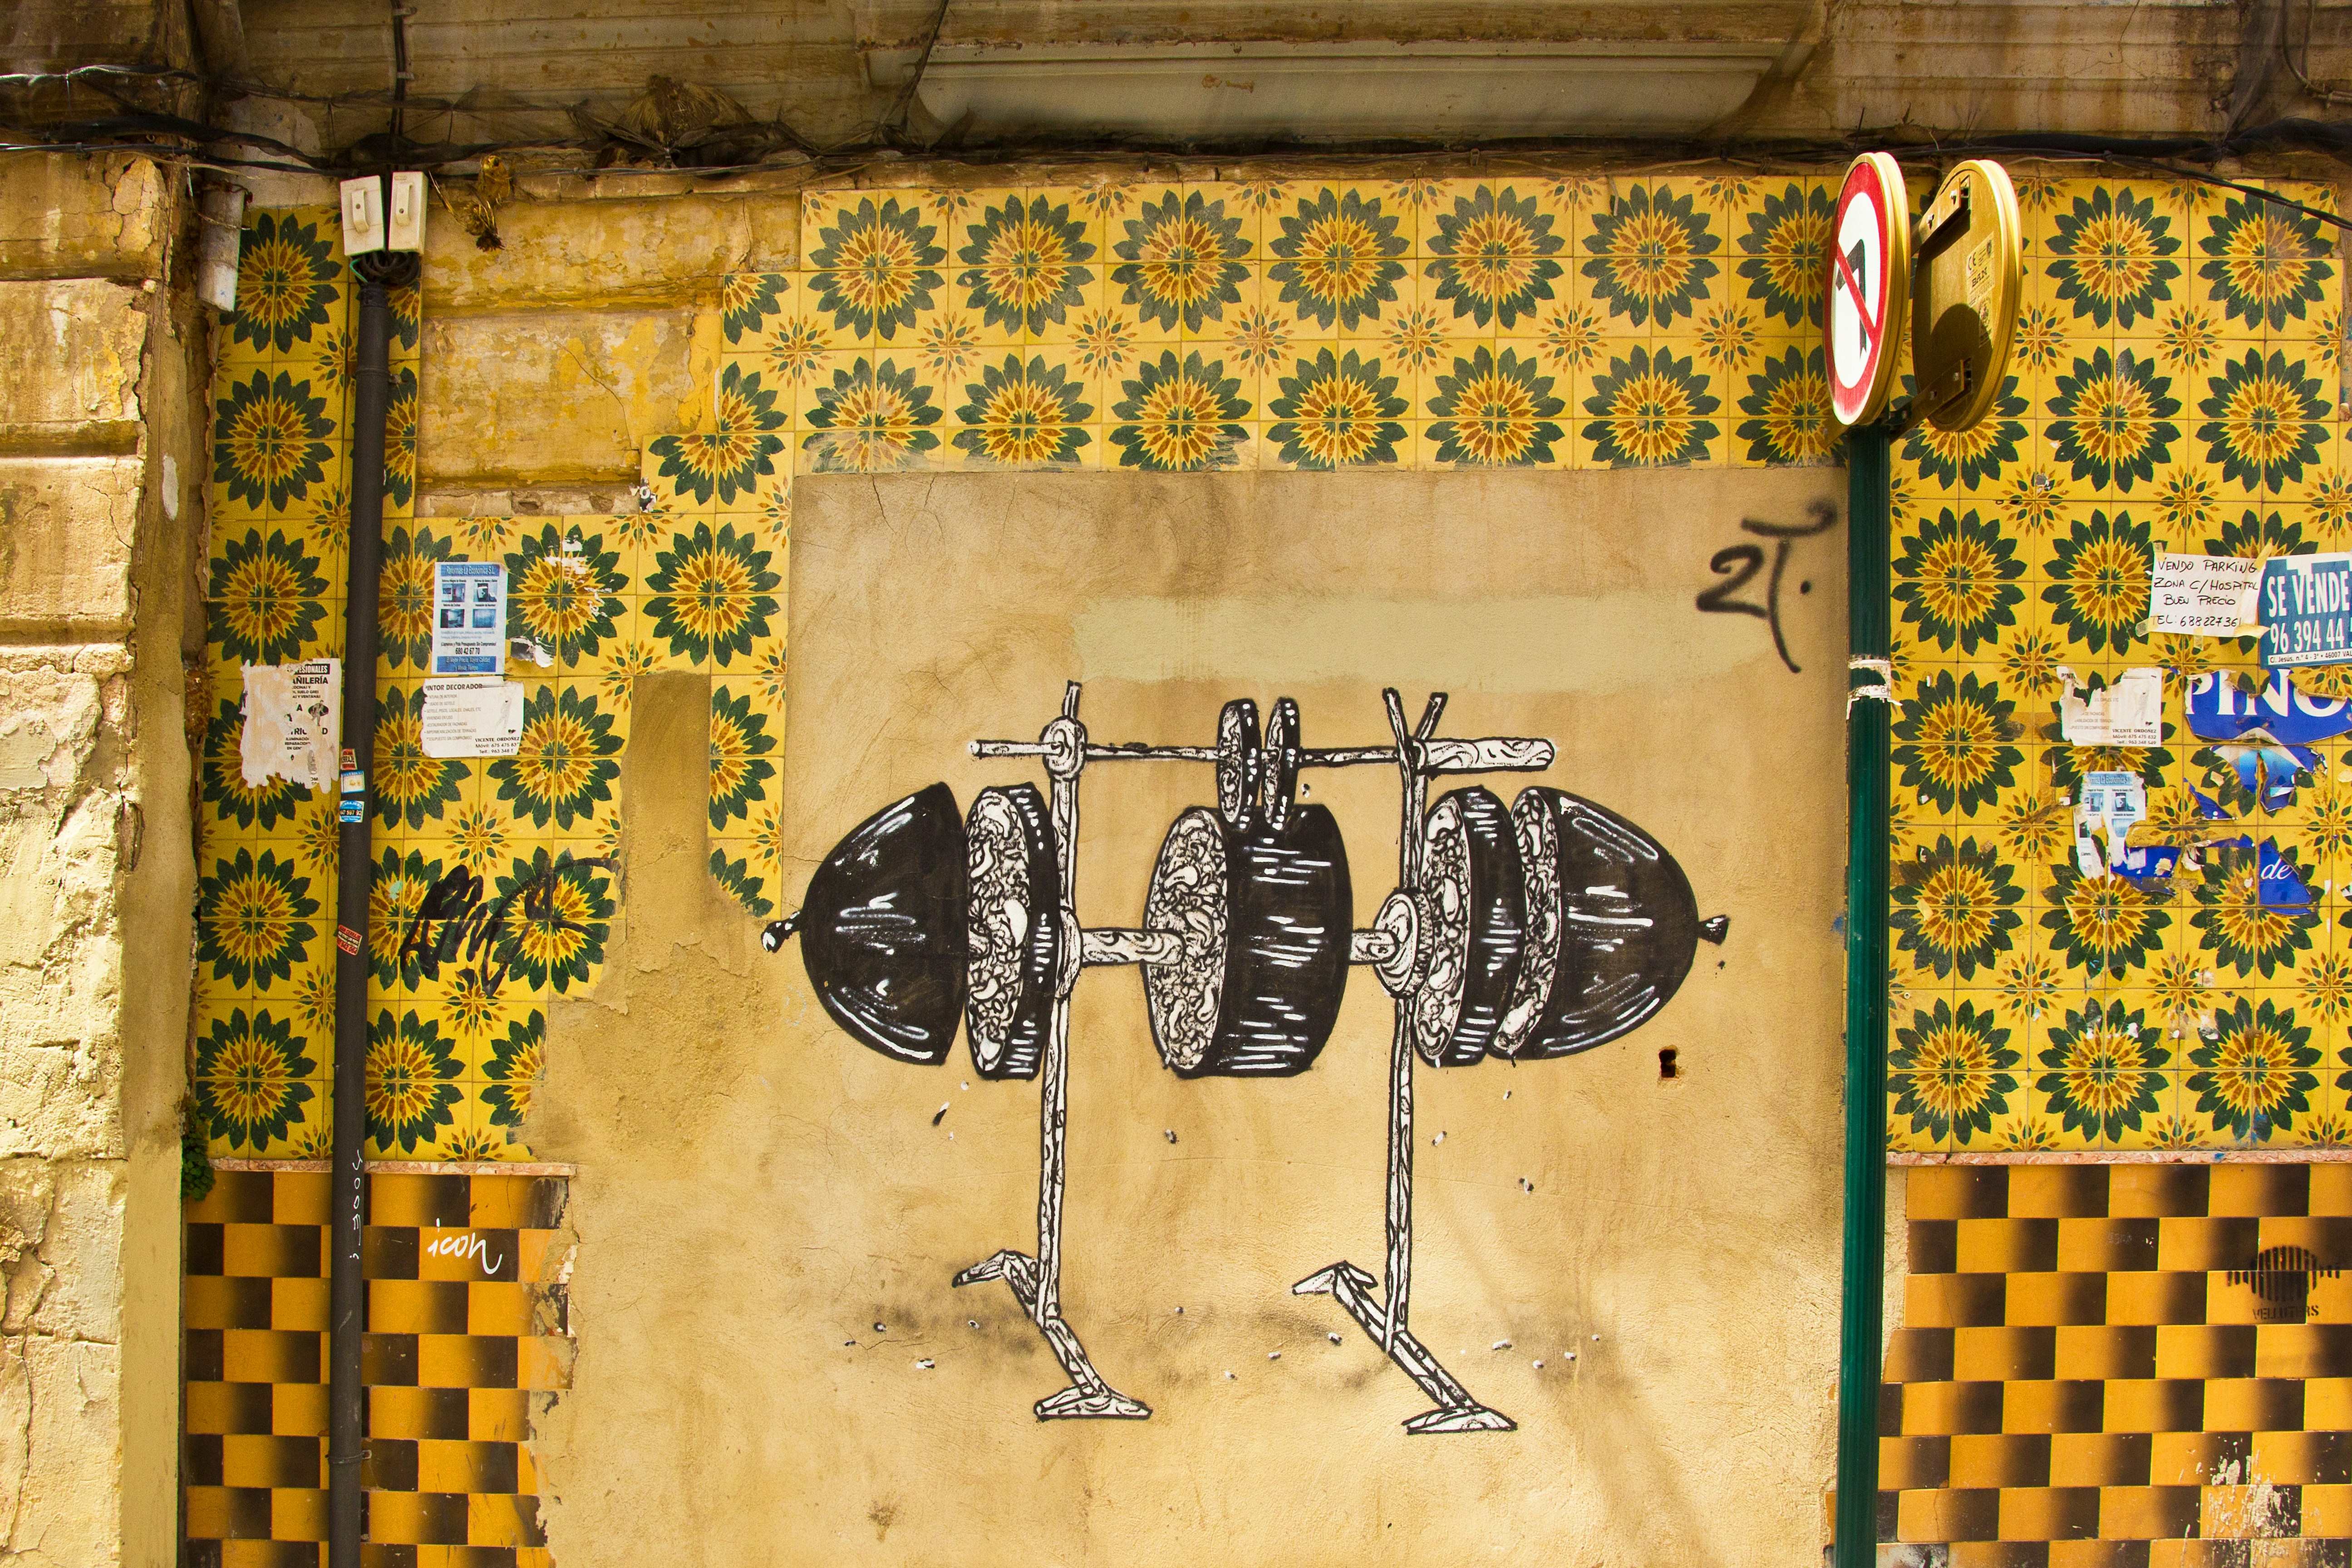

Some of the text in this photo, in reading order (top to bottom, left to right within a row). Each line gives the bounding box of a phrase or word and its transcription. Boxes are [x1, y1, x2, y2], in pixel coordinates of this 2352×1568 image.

[2158, 557, 2194, 573] VENDO
[2154, 577, 2185, 588] ZONA
[2163, 594, 2189, 605] BUEN
[2267, 570, 2351, 618] SE VENDE
[2270, 623, 2289, 654] 96
[2293, 620, 2322, 653] 394
[2326, 618, 2345, 649] 44
[2260, 858, 2293, 880] de
